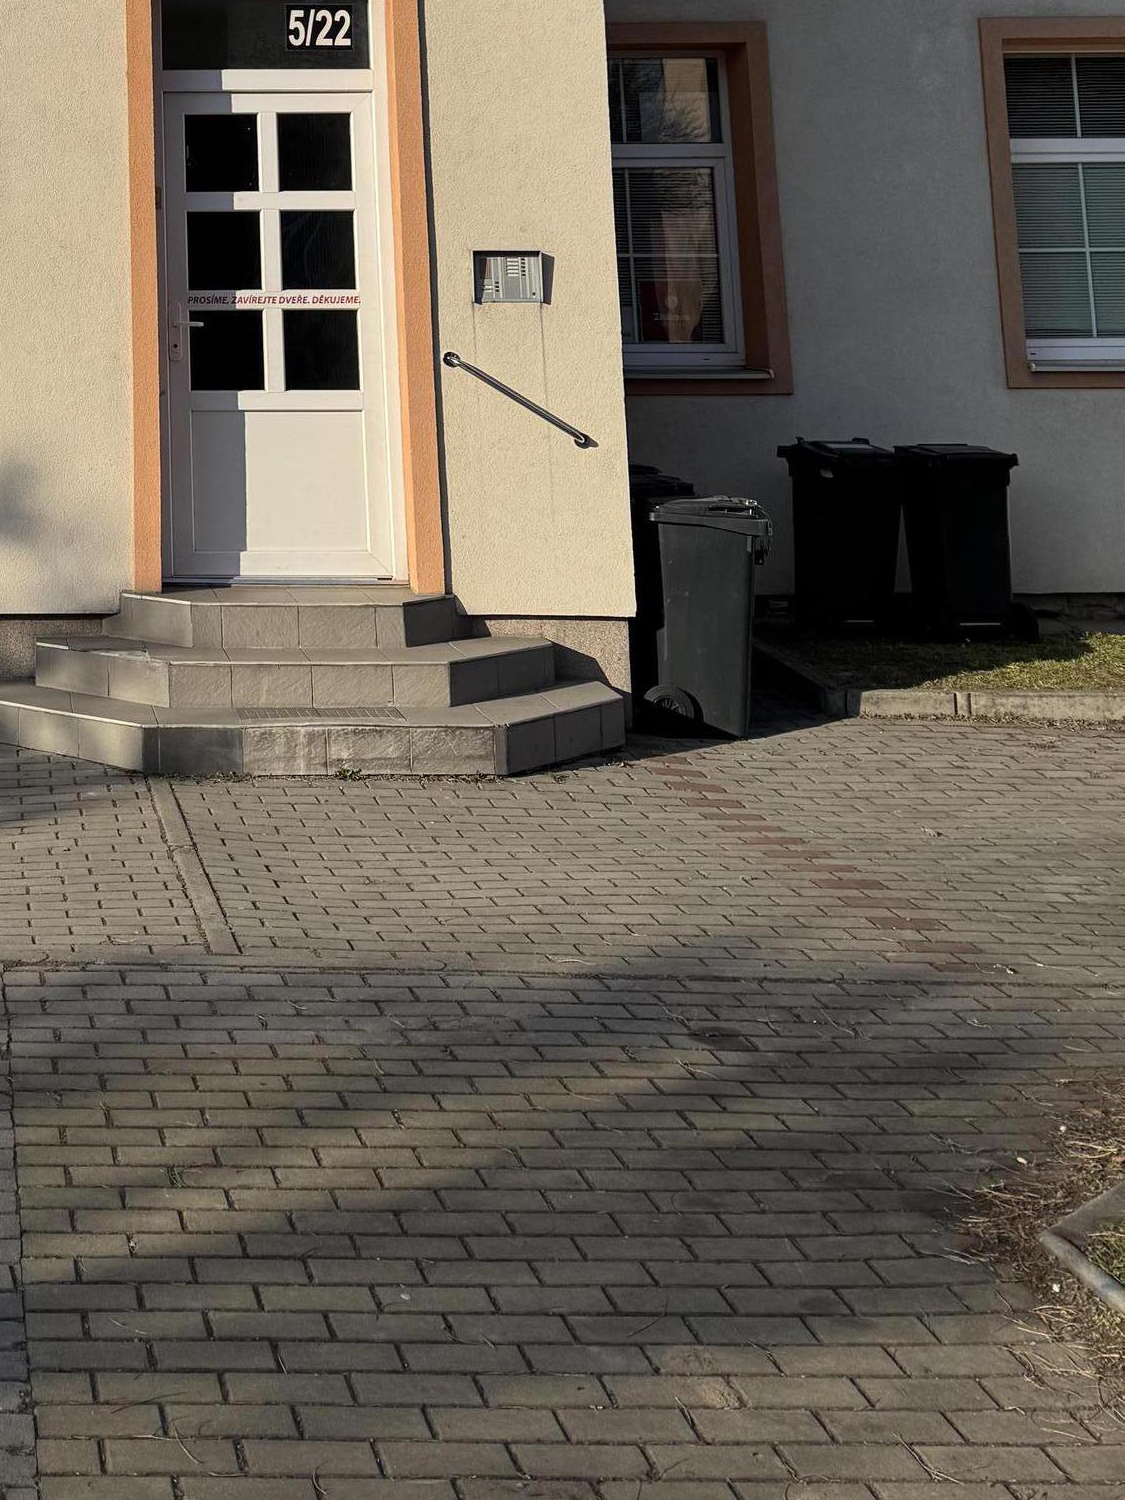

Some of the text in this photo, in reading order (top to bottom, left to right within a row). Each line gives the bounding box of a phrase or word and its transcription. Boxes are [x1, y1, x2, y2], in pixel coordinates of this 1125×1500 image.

[288, 9, 352, 47] 5/22
[233, 294, 278, 305] ZAVÍREJTE
[279, 293, 310, 305] DVEŘE.
[312, 293, 362, 304] DĚKUJEME.
